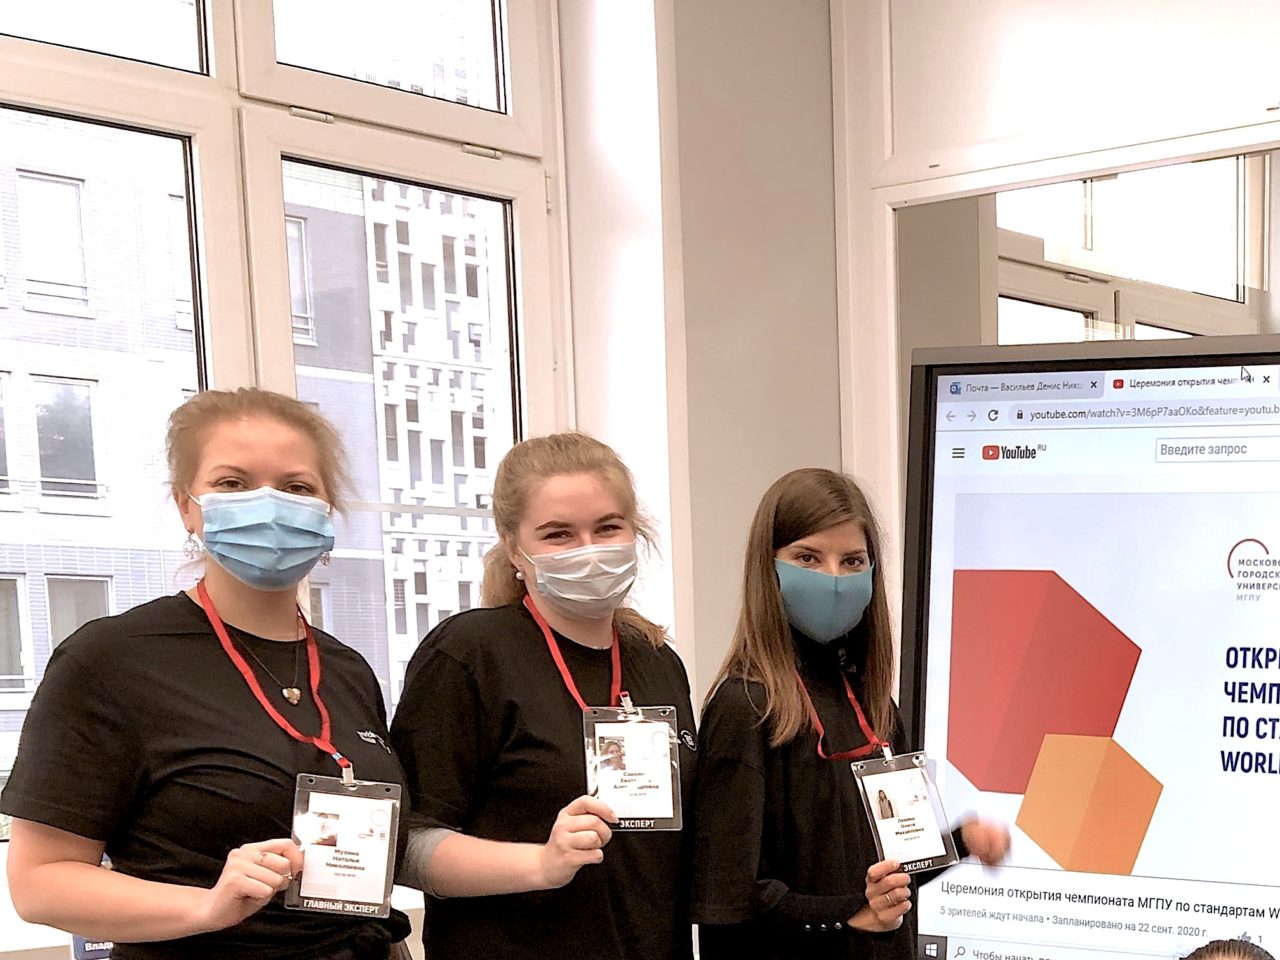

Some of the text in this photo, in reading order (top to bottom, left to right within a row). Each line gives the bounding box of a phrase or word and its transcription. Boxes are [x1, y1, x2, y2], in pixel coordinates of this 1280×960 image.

[966, 382, 989, 393] Почта
[1000, 382, 1035, 392] Васильев
[1037, 381, 1061, 392] Денис
[1129, 378, 1176, 389] Церемония
[1178, 377, 1215, 388] открытия
[1001, 443, 1047, 460] YouTube RU
[1161, 444, 1247, 457] Введите запрос
[1222, 716, 1249, 739] ПО
[620, 819, 655, 828] ЭКСПЕРТ
[903, 859, 933, 872] ЭКСПЕРТ
[303, 899, 380, 914] ГЛАВНЫЙ ЭКСПЕРТ
[940, 881, 1005, 899] Церемония
[1007, 887, 1062, 902] открытия
[1064, 892, 1135, 909] чемпионата
[1138, 897, 1173, 911] МГПУ
[1175, 901, 1190, 913] по
[1193, 902, 1265, 919] стандартам
[939, 906, 1209, 938] 5 зрителей ждут начала Запланировано на 22 сент. 2020 г.
